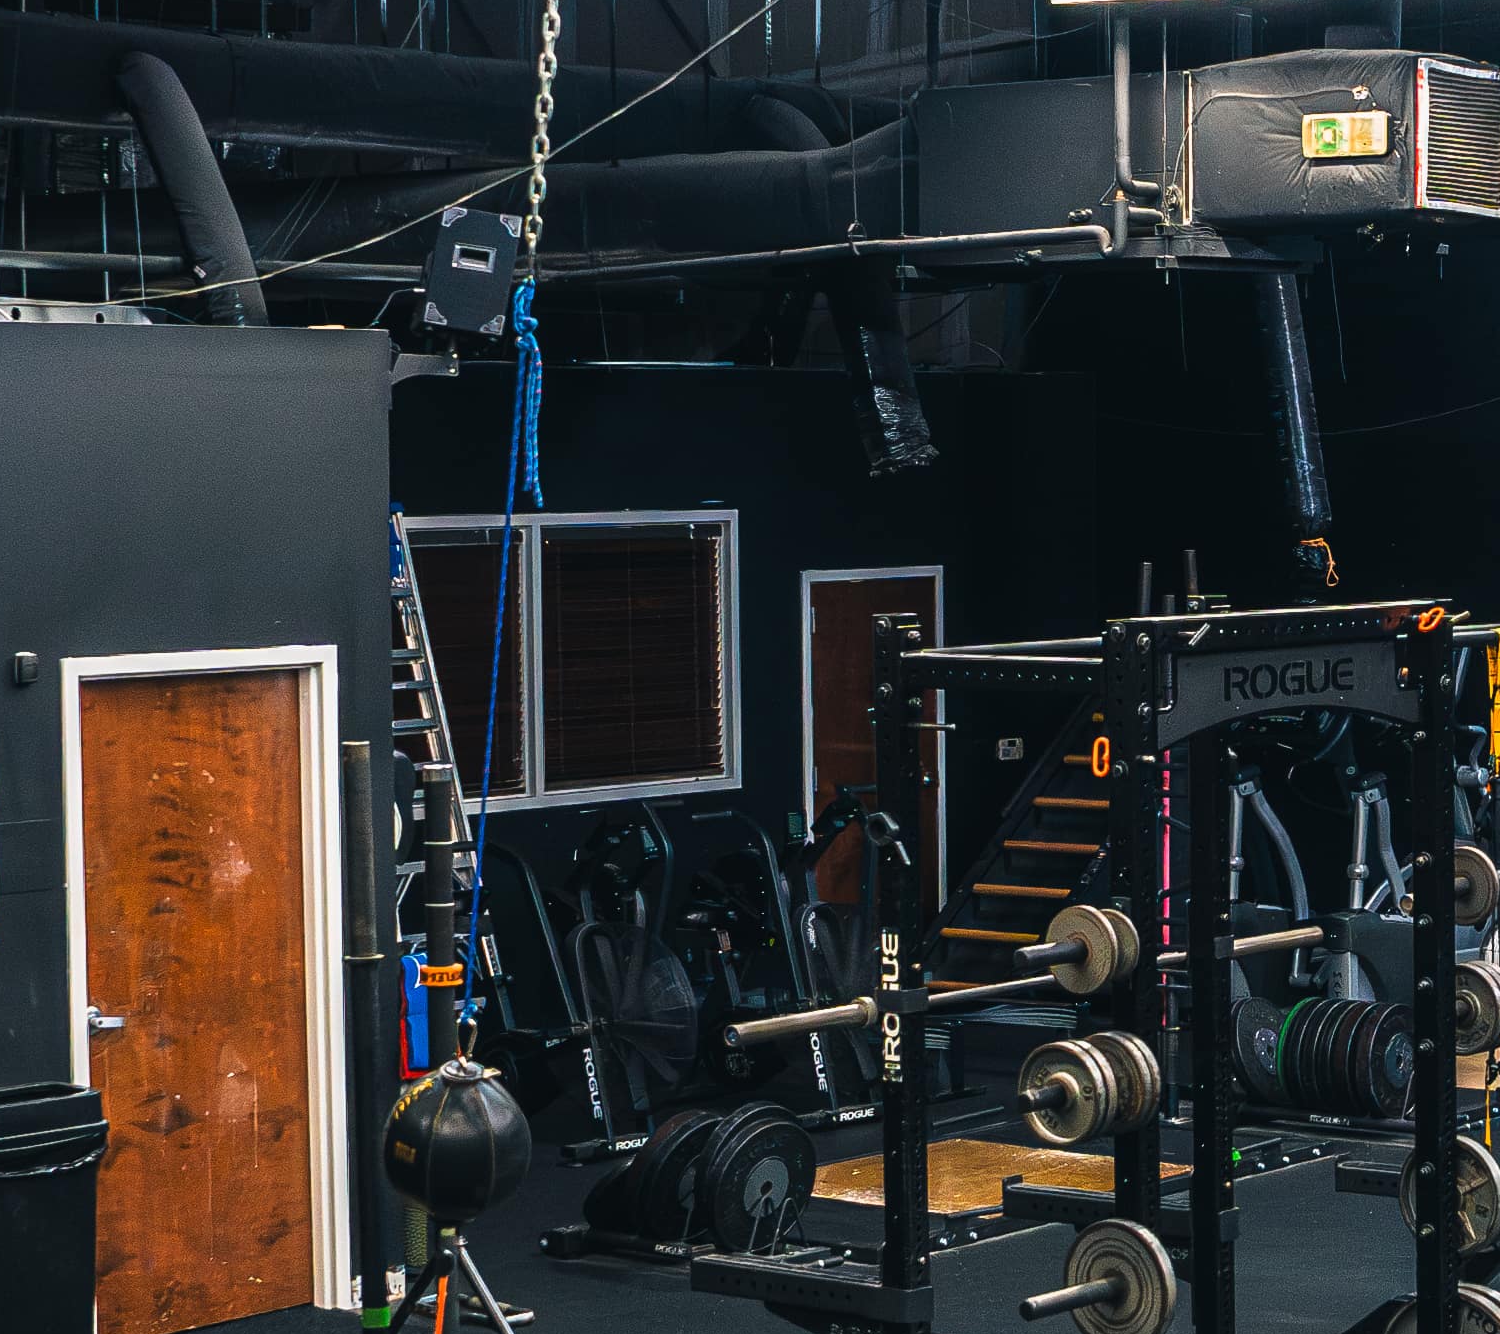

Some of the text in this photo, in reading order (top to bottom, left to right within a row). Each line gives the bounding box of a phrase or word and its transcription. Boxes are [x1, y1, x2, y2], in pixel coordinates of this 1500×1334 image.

[1223, 657, 1355, 702] ROGUE
[581, 1047, 604, 1120] ROGUE
[838, 1106, 877, 1123] ROGUE
